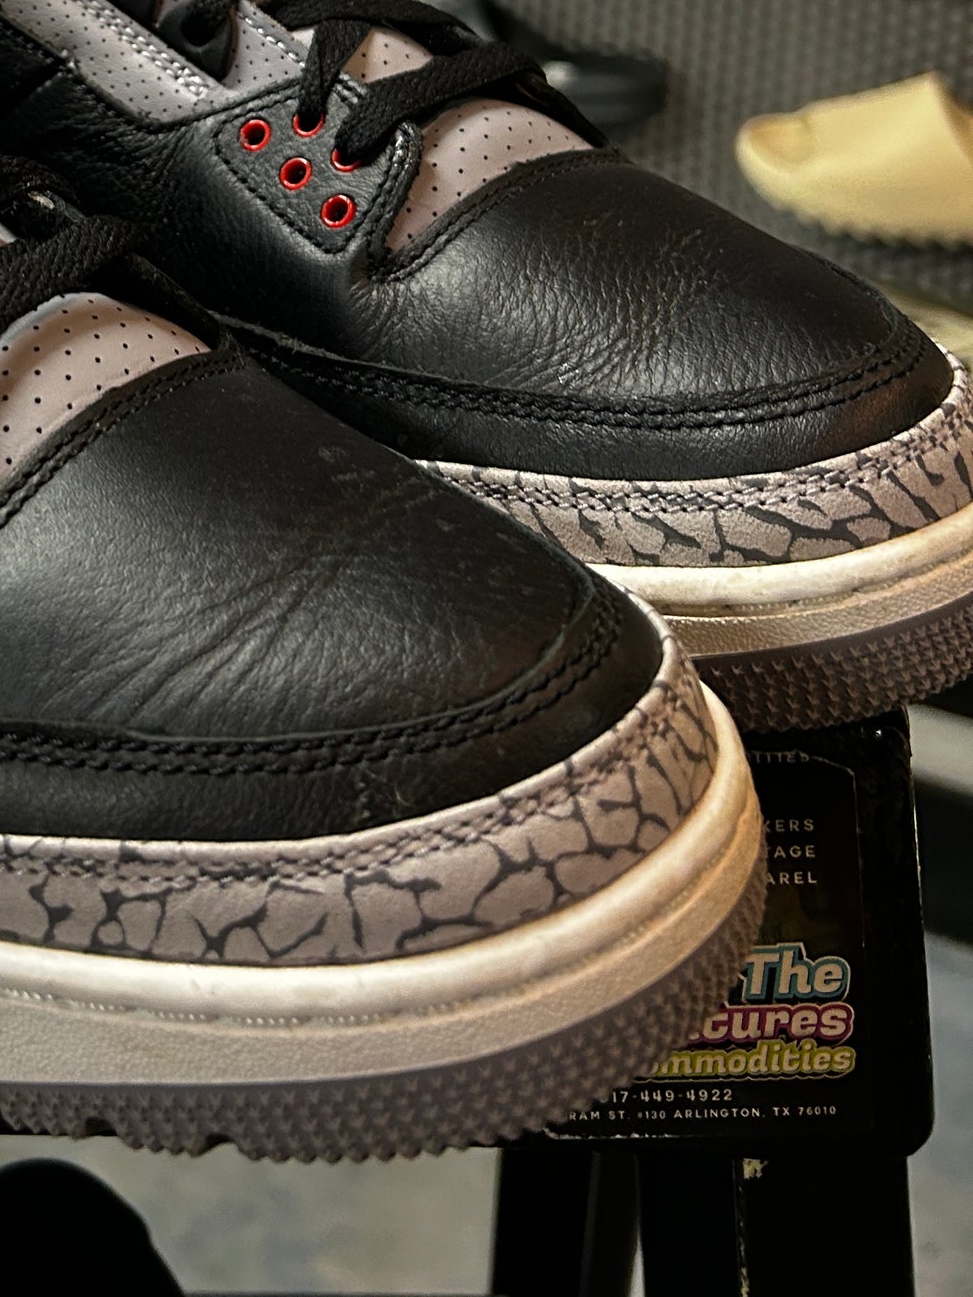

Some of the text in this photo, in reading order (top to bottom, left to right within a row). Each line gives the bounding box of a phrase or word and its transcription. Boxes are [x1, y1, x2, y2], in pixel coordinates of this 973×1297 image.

[767, 844, 816, 858] AGE
[746, 948, 845, 996] The
[688, 1004, 849, 1041] tures
[612, 1089, 733, 1103] 17-449-4922
[673, 1107, 766, 1119] ARLINGTON,
[772, 1106, 791, 1117] TX
[798, 1105, 837, 1117] 76010
